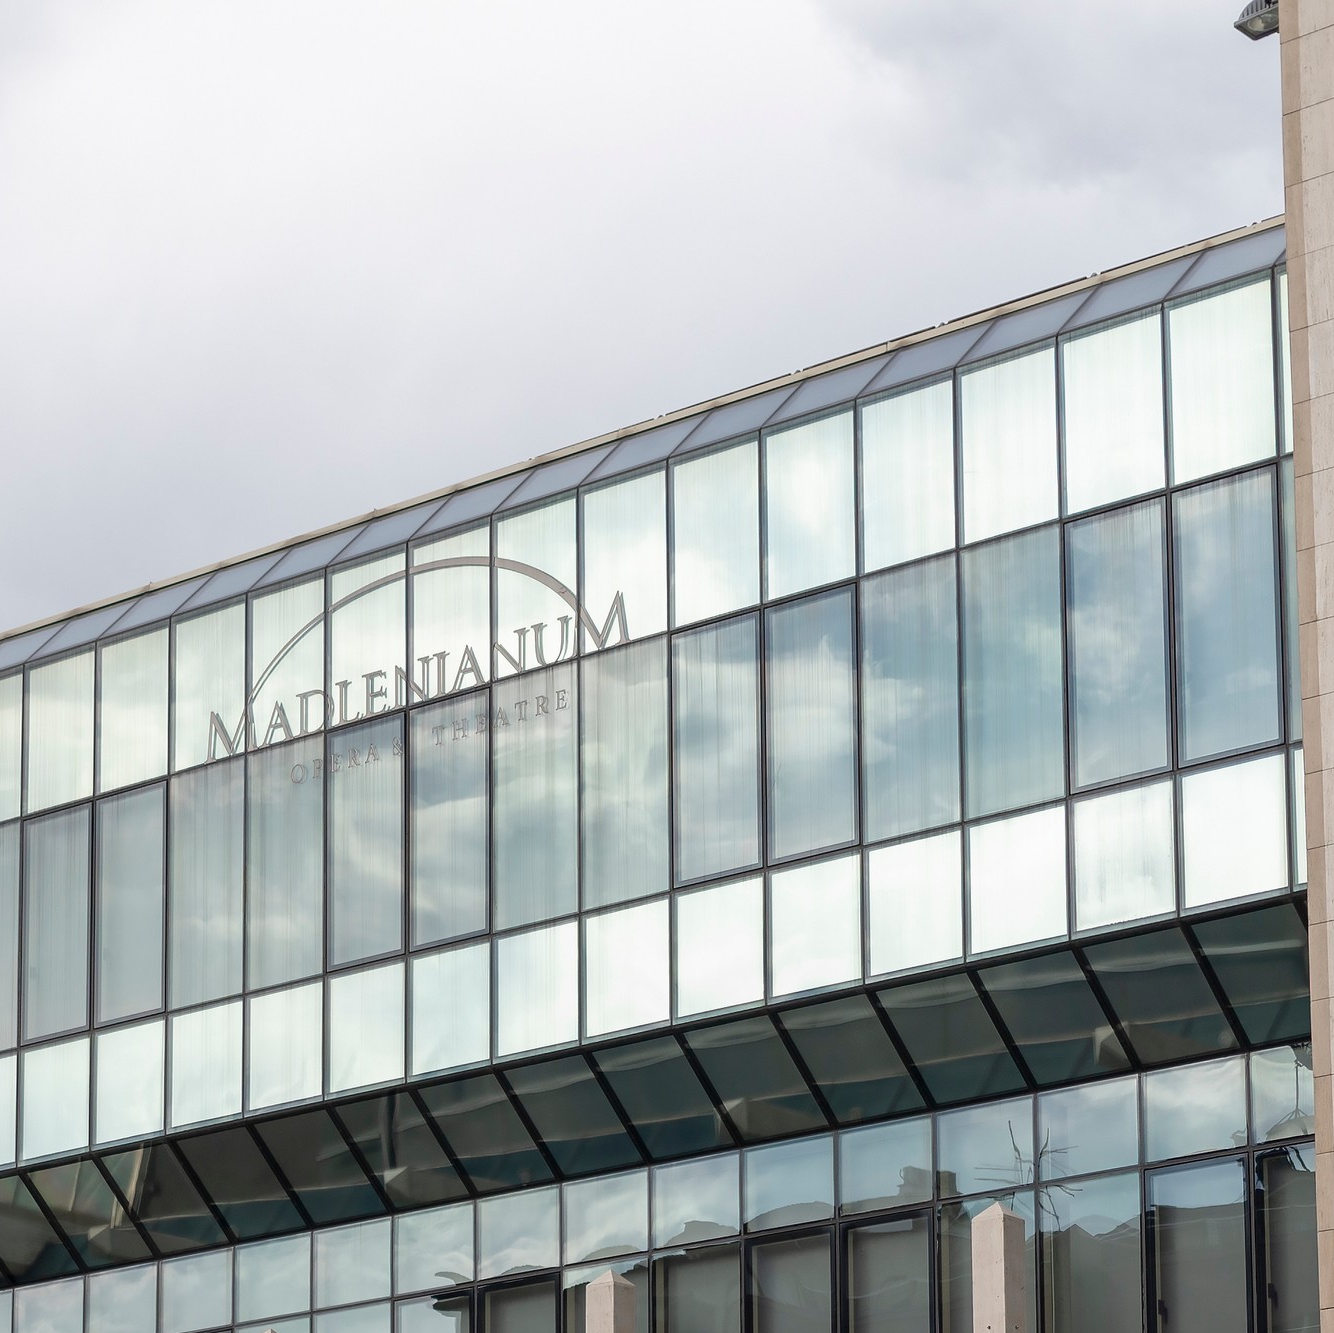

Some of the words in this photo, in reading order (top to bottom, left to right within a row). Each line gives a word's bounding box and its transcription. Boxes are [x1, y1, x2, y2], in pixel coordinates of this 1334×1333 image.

[204, 591, 631, 764] MADLENIANUM
[290, 742, 381, 784] OPERA
[391, 736, 405, 756] &
[432, 688, 571, 747] THEATRE
